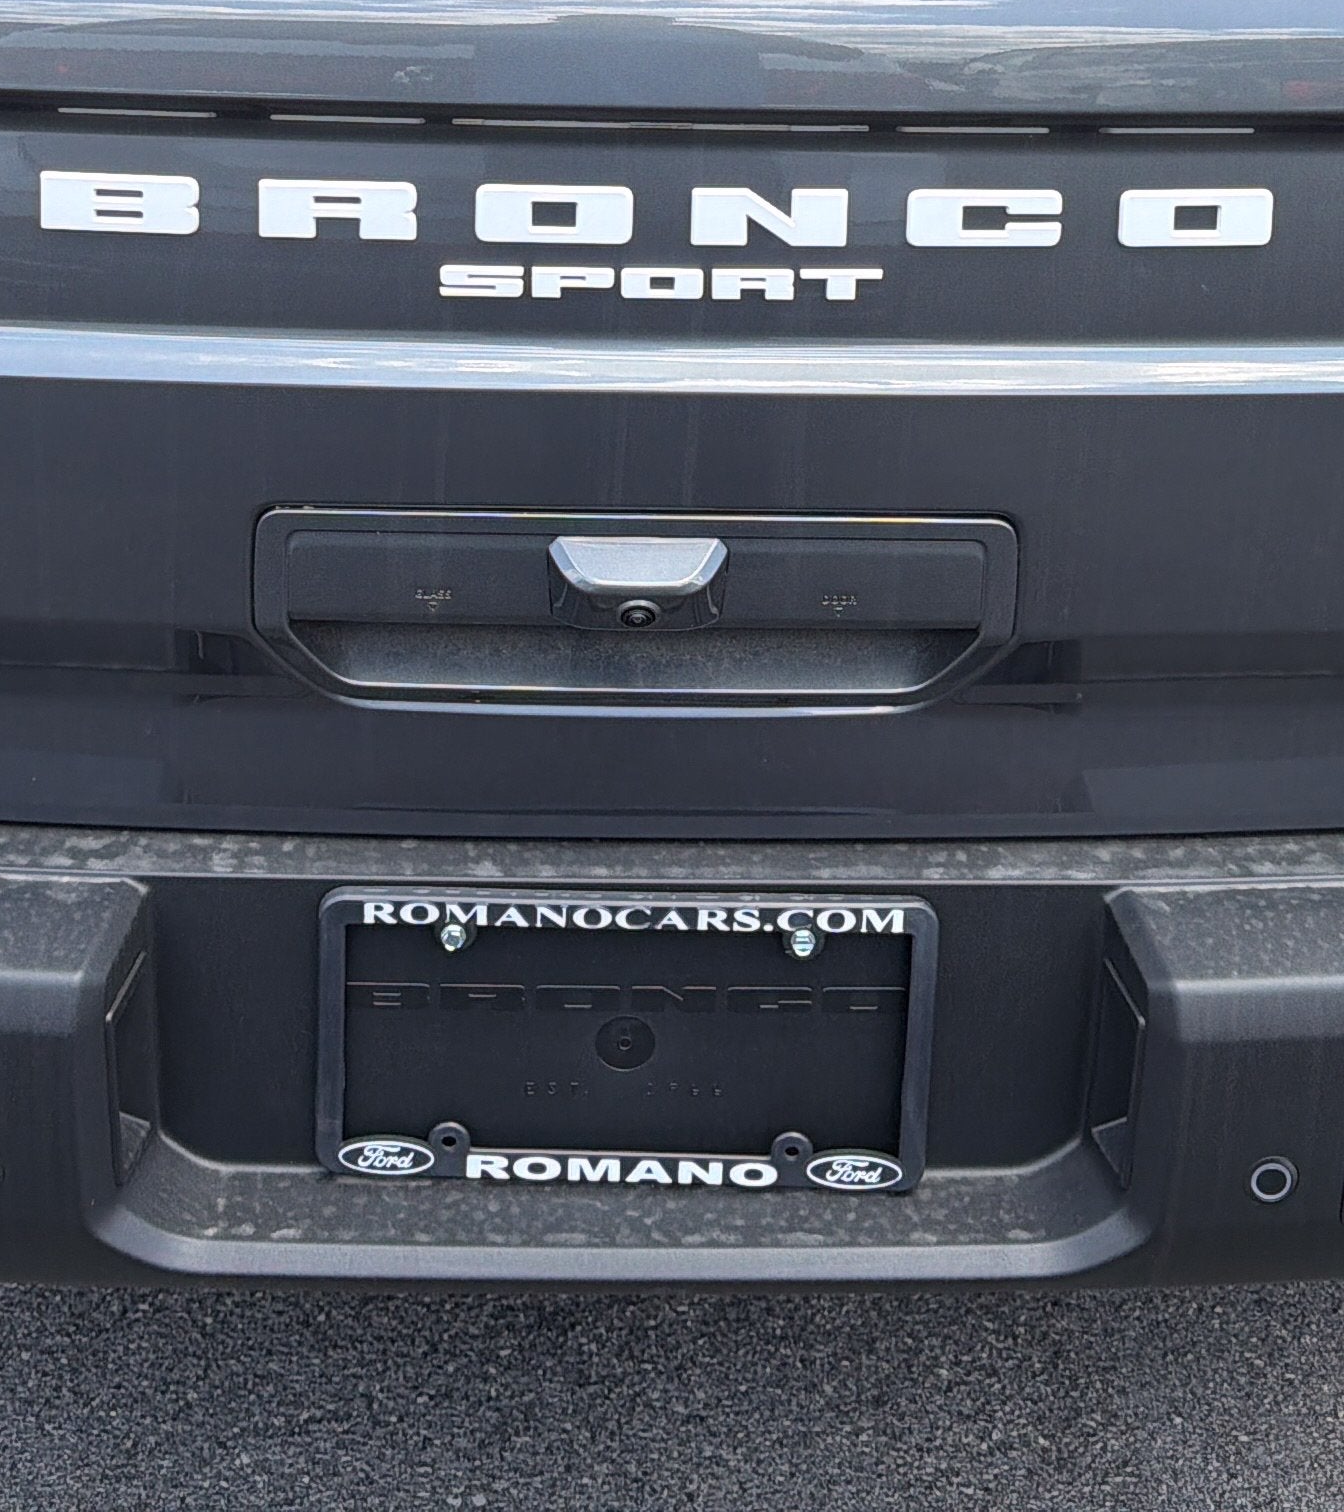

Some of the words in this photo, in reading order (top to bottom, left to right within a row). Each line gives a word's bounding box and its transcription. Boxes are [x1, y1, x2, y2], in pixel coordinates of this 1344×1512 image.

[39, 170, 1275, 248] BRONCO
[438, 264, 884, 301] SPORT
[362, 900, 905, 935] ROMANOCARS.COM
[465, 1153, 779, 1188] ROMANO
